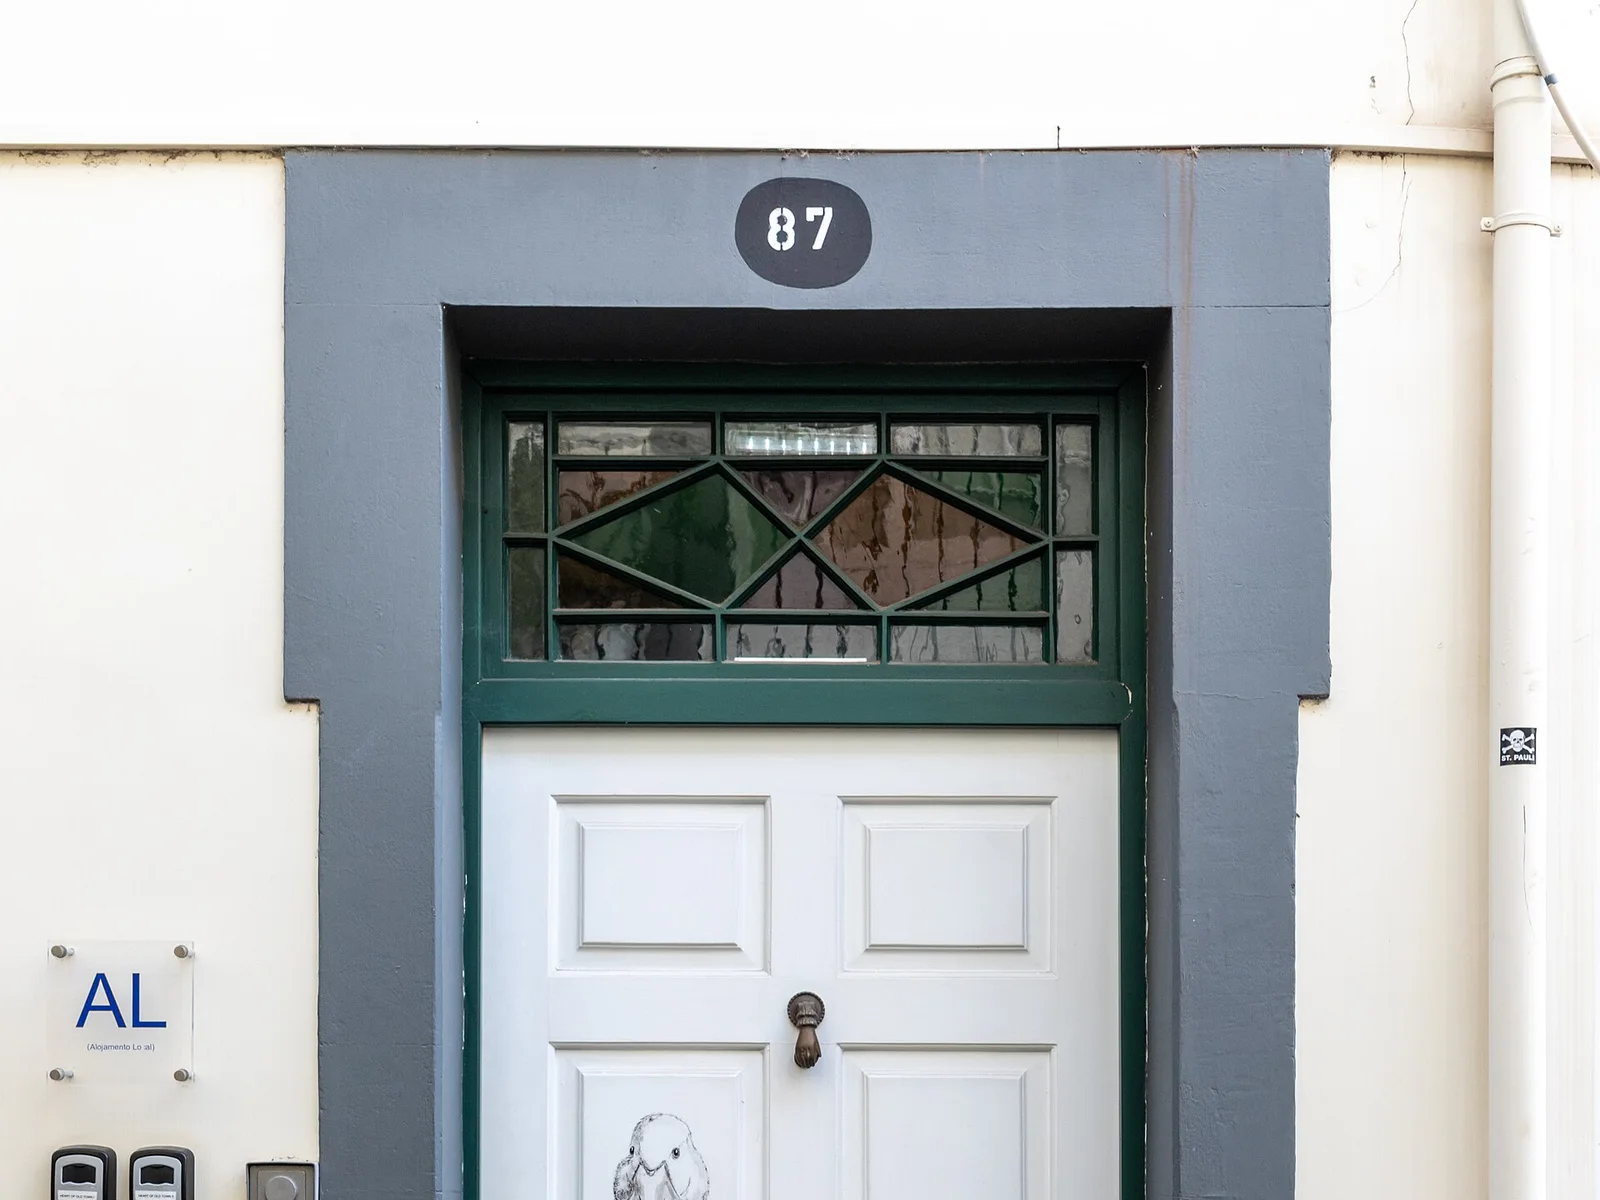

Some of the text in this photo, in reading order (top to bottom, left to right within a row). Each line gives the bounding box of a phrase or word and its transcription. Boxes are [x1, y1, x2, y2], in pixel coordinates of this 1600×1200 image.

[767, 206, 833, 251] 87
[1501, 754, 1535, 762] ST. PAULI
[75, 972, 167, 1028] AL
[86, 1043, 131, 1052] (Alojamento
